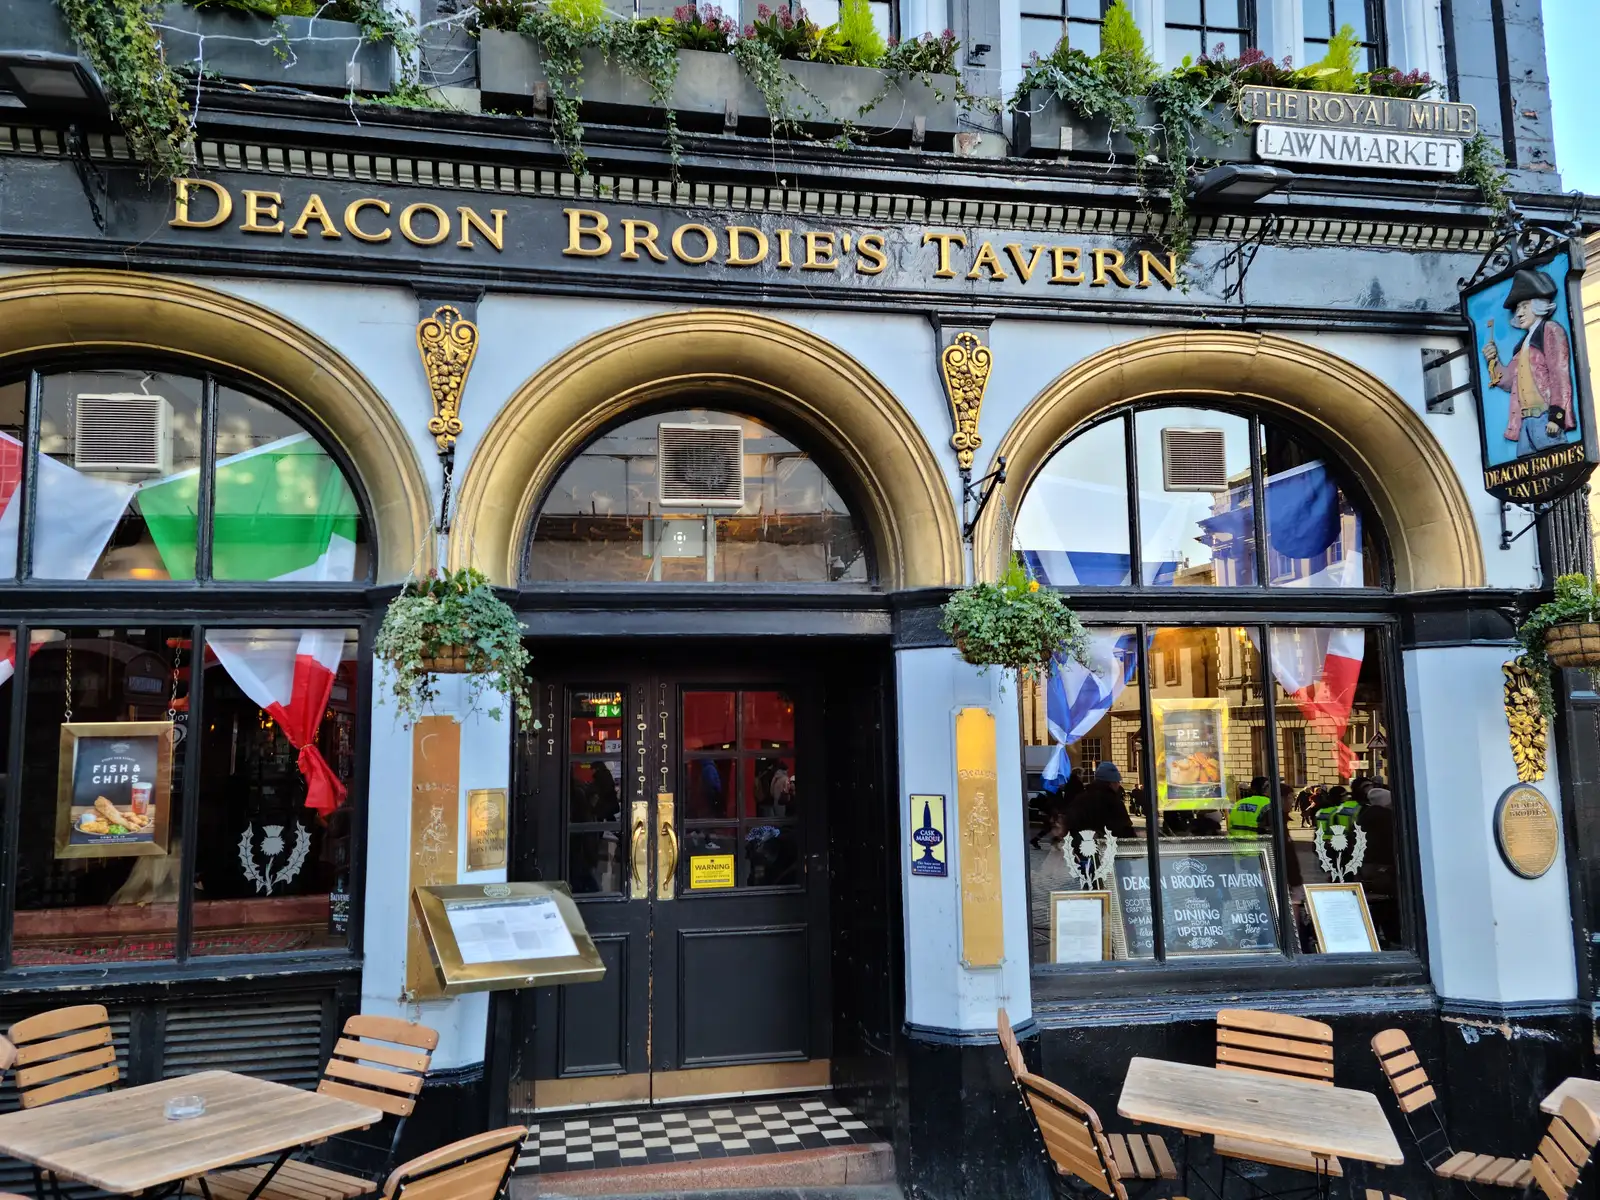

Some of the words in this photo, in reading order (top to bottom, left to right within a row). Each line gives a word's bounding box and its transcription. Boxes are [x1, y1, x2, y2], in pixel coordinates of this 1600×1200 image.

[1245, 90, 1298, 119] THE
[1307, 95, 1397, 127] ROYAL
[1408, 104, 1472, 132] MILE
[1263, 128, 1457, 168] LAWNMARKET
[168, 177, 508, 251] DEACON
[562, 207, 889, 275] BRODIE'S
[923, 232, 1181, 289] TAVERN
[1484, 462, 1530, 489] DEACON
[1531, 445, 1585, 476] BRODIE'S
[1505, 473, 1564, 498] TAVERN
[1177, 729, 1200, 739] PIE
[93, 764, 128, 773] FISH
[132, 764, 141, 773] &
[92, 775, 139, 784] CHIPS
[1122, 875, 1168, 890] DEACN
[1170, 874, 1215, 889] BRODIES
[1219, 873, 1263, 888] TAVERN
[1174, 909, 1220, 921] DINING
[1231, 912, 1269, 924] MUSIC
[1177, 925, 1224, 937] UPSTAIRS
